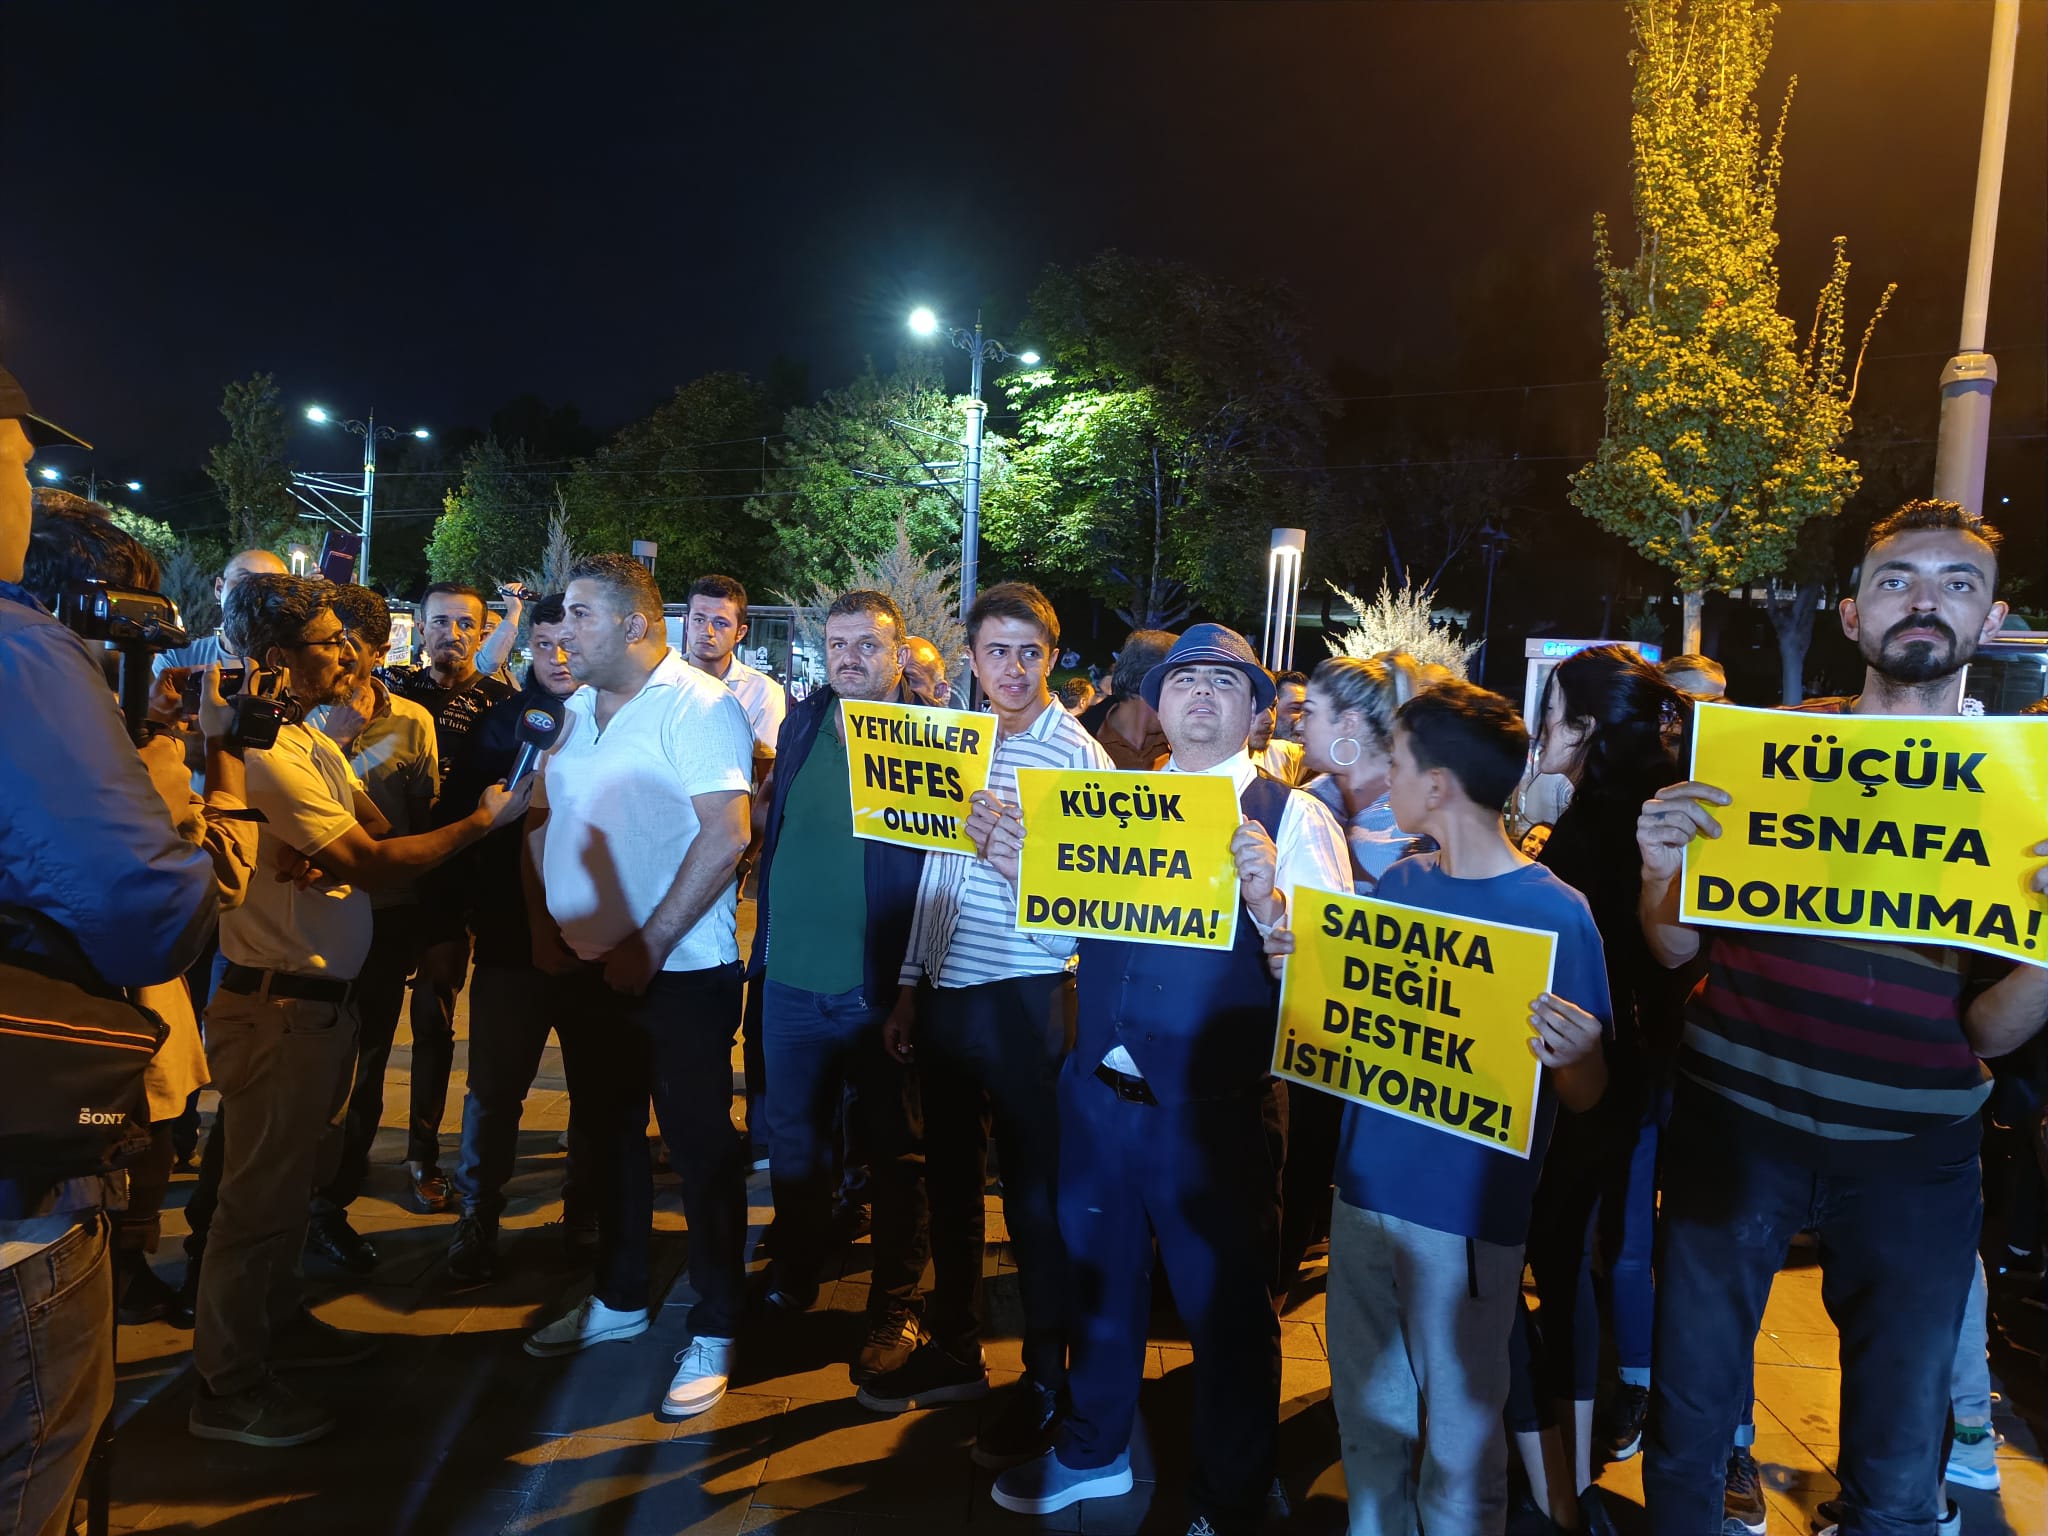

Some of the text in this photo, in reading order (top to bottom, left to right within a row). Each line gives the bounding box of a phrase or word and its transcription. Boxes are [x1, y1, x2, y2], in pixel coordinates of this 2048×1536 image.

[528, 713, 552, 729] SZC
[849, 713, 980, 755] YETKİLİLER
[864, 753, 964, 803] NEFES
[1762, 734, 1988, 798] KÜÇÜK
[883, 806, 957, 840] OLUN!
[1060, 782, 1185, 829] KÜÇÜK
[1057, 843, 1192, 880] ESNAFA
[1748, 811, 1991, 867] ESNAFA
[1026, 894, 1220, 940] DOKUNMA!
[1697, 875, 2042, 950] DOKUNMA!
[1321, 903, 1495, 974] SADAKA
[1342, 955, 1462, 1018] DEĞİL
[1322, 998, 1476, 1075] DESTEK
[1282, 1028, 1513, 1142] İSTİYORUZ!
[79, 1112, 126, 1125] SONY
